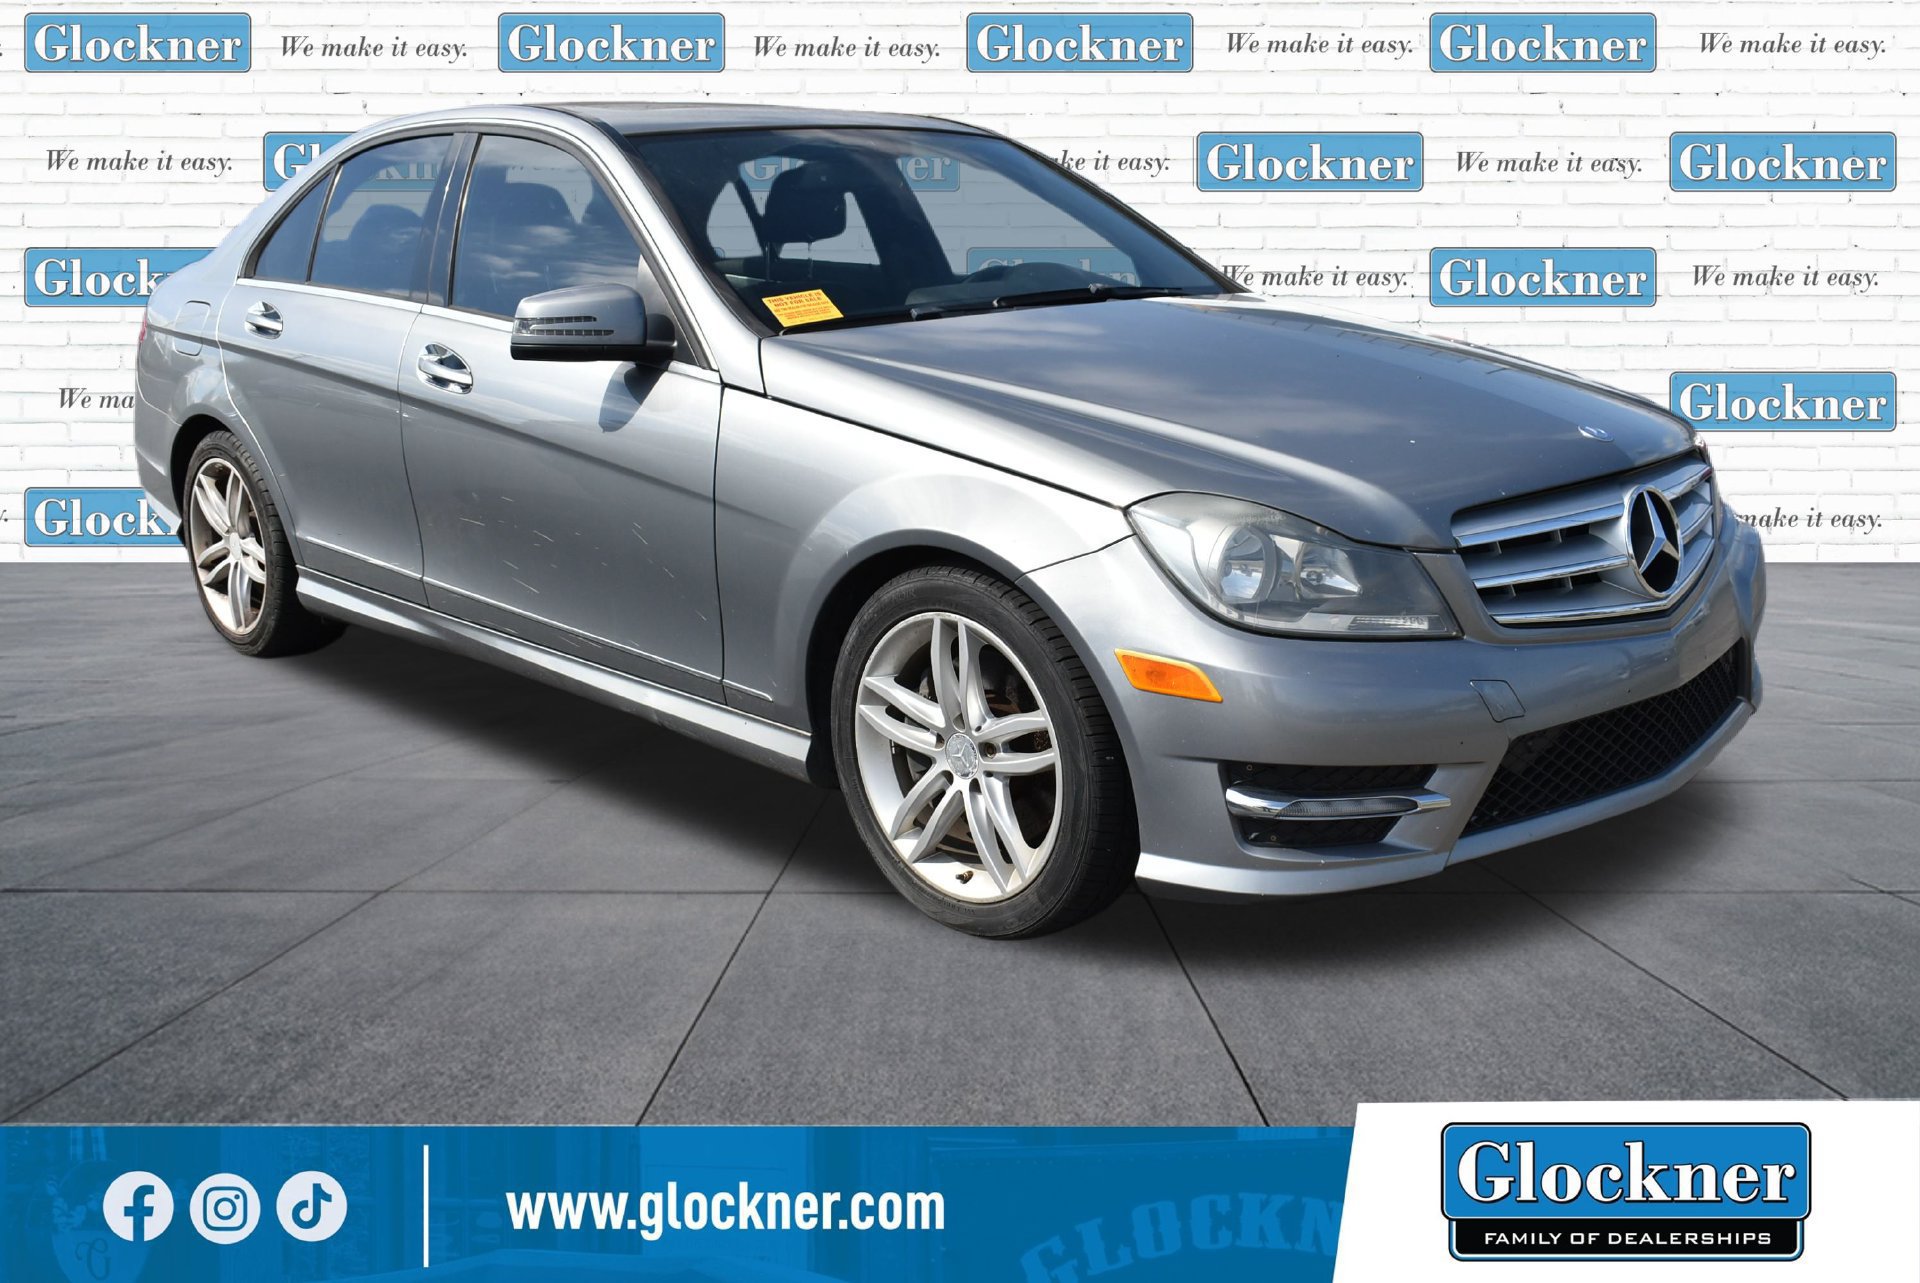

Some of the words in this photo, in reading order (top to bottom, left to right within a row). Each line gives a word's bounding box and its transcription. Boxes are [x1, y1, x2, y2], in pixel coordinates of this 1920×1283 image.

[34, 24, 242, 63] Glockner
[282, 36, 314, 57] We
[322, 36, 383, 57] make
[392, 36, 407, 57] it
[416, 43, 467, 64] easy.
[508, 24, 716, 63] Glockner
[755, 36, 787, 57] We
[795, 36, 856, 57] make
[865, 36, 880, 57] it
[889, 43, 940, 64] easy.
[977, 24, 1185, 63] Glockner
[1228, 32, 1260, 53] We
[1268, 32, 1329, 53] make
[1338, 32, 1353, 53] it
[1362, 39, 1413, 60] easy.
[1439, 24, 1647, 63] Glockner
[1701, 32, 1733, 53] We
[1741, 32, 1802, 53] make
[1811, 32, 1826, 53] it
[1835, 39, 1886, 60] easy.
[46, 149, 78, 170] We
[86, 149, 147, 170] make
[156, 149, 171, 170] it
[180, 156, 231, 177] easy.
[1094, 150, 1109, 171] it
[1117, 157, 1171, 177] easy.
[1207, 143, 1415, 182] Glockner
[1457, 151, 1489, 172] We
[1497, 151, 1558, 172] make
[1567, 151, 1582, 172] it
[1591, 158, 1642, 179] easy.
[1679, 143, 1887, 182] Glockner
[34, 258, 170, 296] Glock
[1262, 265, 1324, 286] make
[1332, 265, 1347, 286] it
[1356, 272, 1407, 293] easy.
[1439, 258, 1647, 297] Glockner
[1694, 265, 1726, 286] We
[1734, 265, 1795, 286] make
[1804, 265, 1819, 286] it
[1828, 272, 1879, 293] easy.
[59, 387, 92, 409] We
[100, 394, 134, 409] ma
[1679, 383, 1887, 422] Glockner
[34, 498, 178, 536] Glock
[1807, 507, 1822, 528] it
[1830, 513, 1882, 535] easy.
